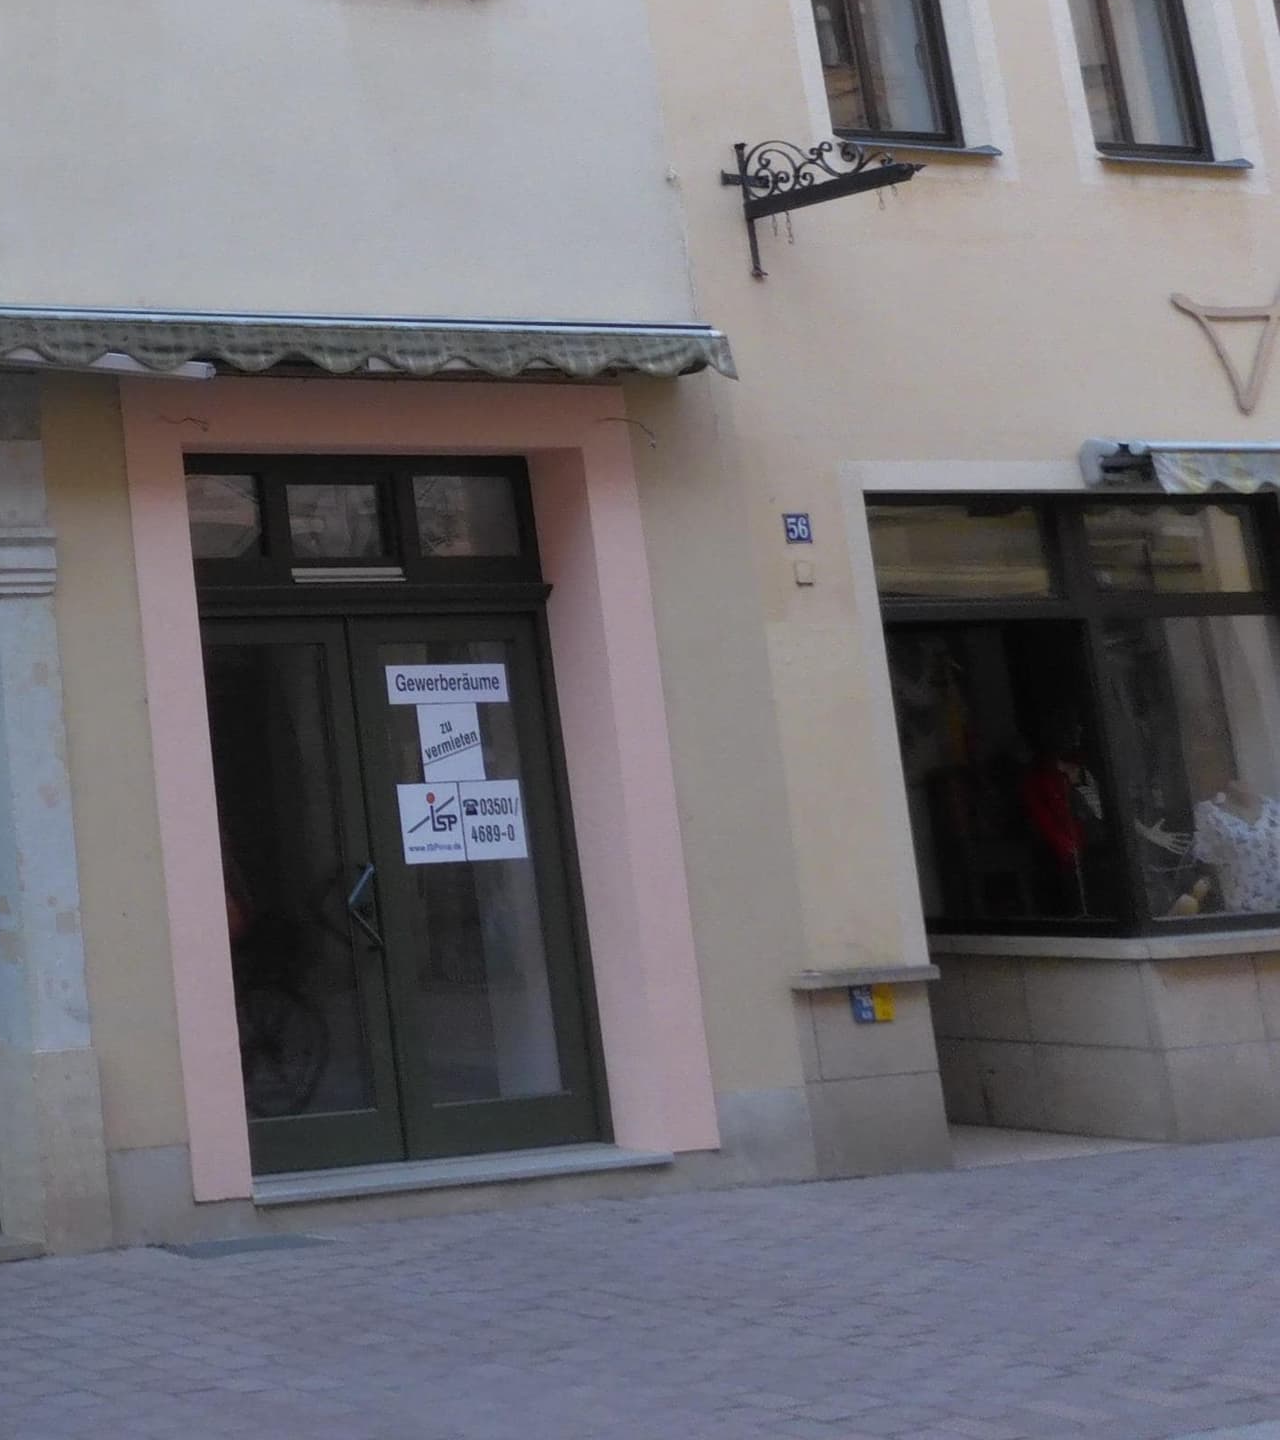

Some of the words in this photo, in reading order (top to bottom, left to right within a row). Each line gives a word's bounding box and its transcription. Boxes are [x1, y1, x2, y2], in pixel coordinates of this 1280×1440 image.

[786, 516, 809, 539] 56
[395, 672, 500, 693] Gewerberäume
[439, 719, 453, 734] zu
[424, 729, 479, 760] vermieten
[471, 824, 515, 843] 4689-0
